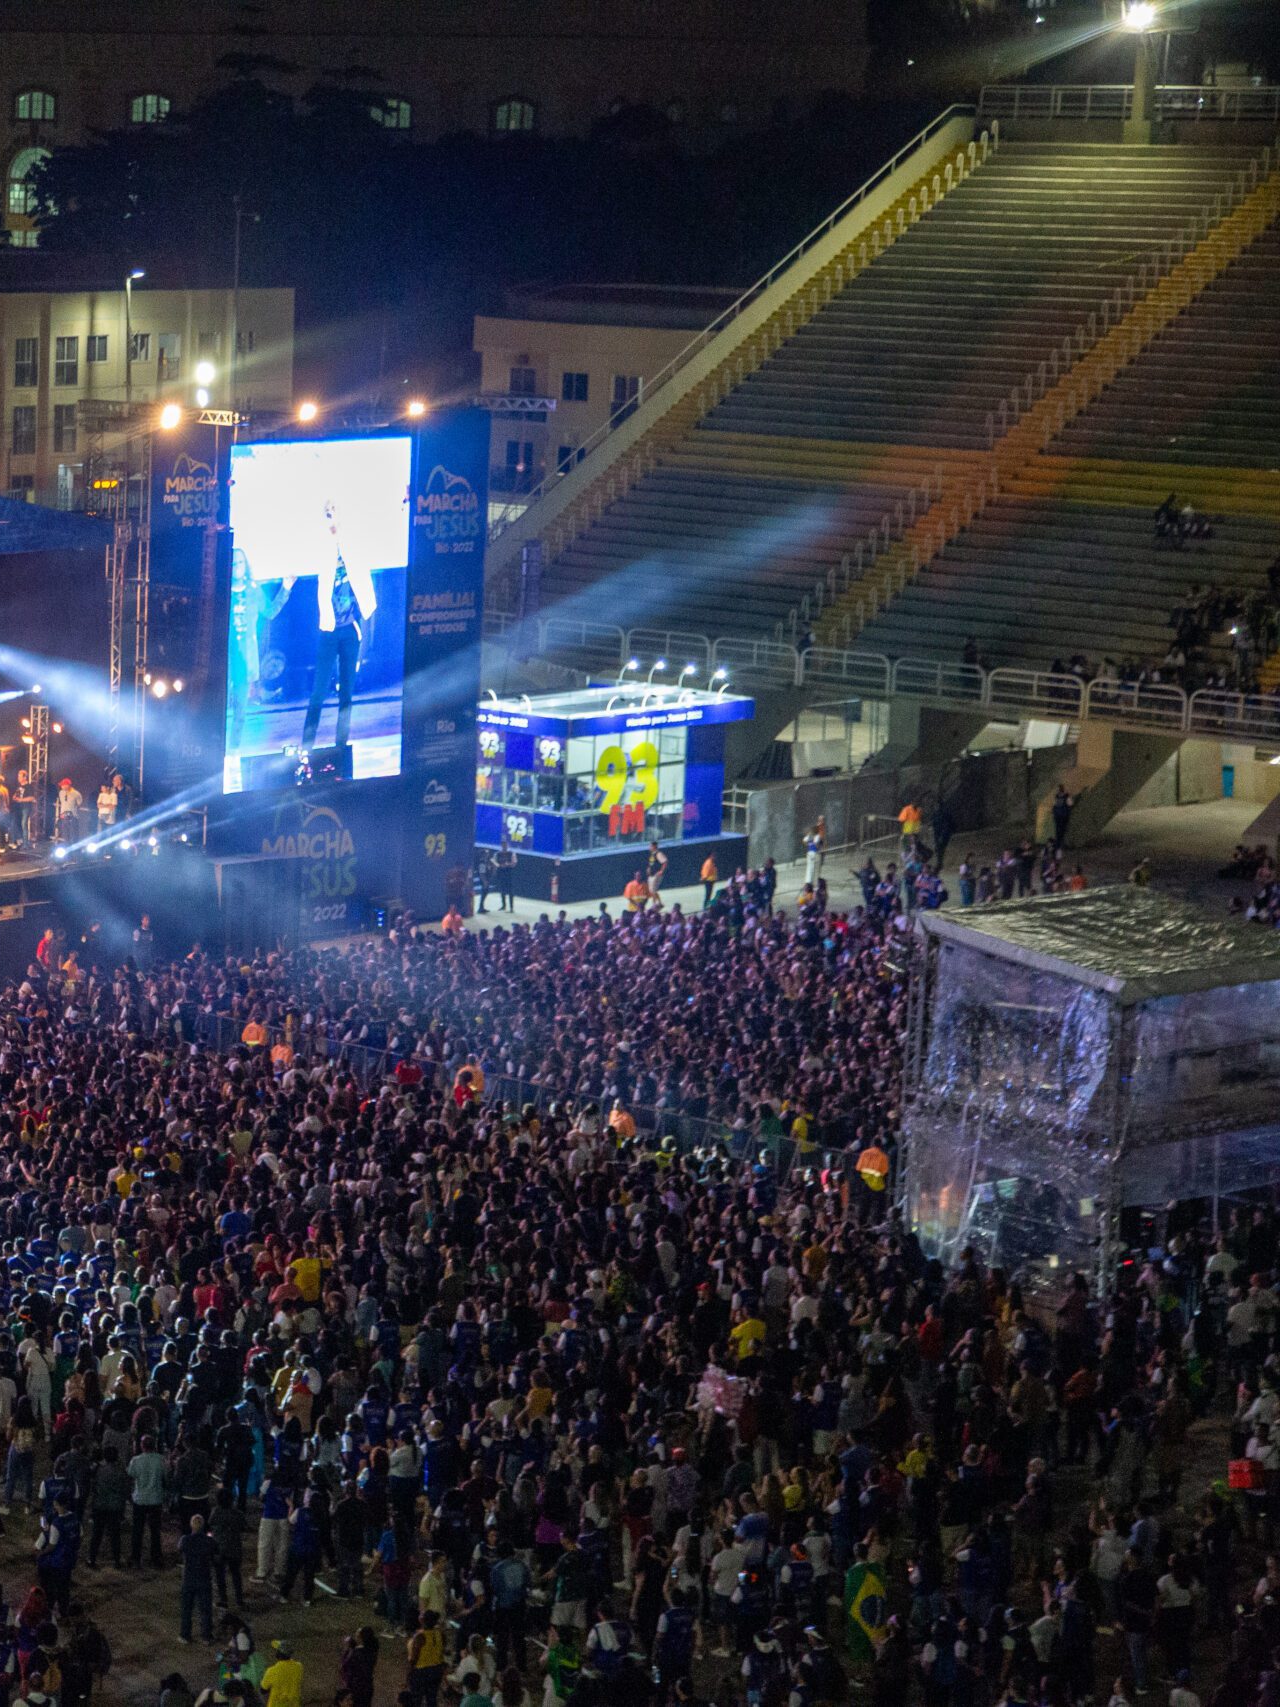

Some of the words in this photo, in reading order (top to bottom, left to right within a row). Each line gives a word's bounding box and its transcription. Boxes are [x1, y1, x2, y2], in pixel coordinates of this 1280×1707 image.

[417, 491, 478, 513] MARCHA
[426, 511, 480, 539] JESUS
[479, 731, 500, 754] 93
[540, 740, 561, 762] 93
[596, 741, 659, 814] 93
[506, 815, 527, 837] 93
[608, 801, 645, 837] FM
[261, 829, 355, 860] MARCHA
[425, 833, 446, 857] 93
[308, 858, 358, 898] SUS
[313, 904, 347, 922] 2022
